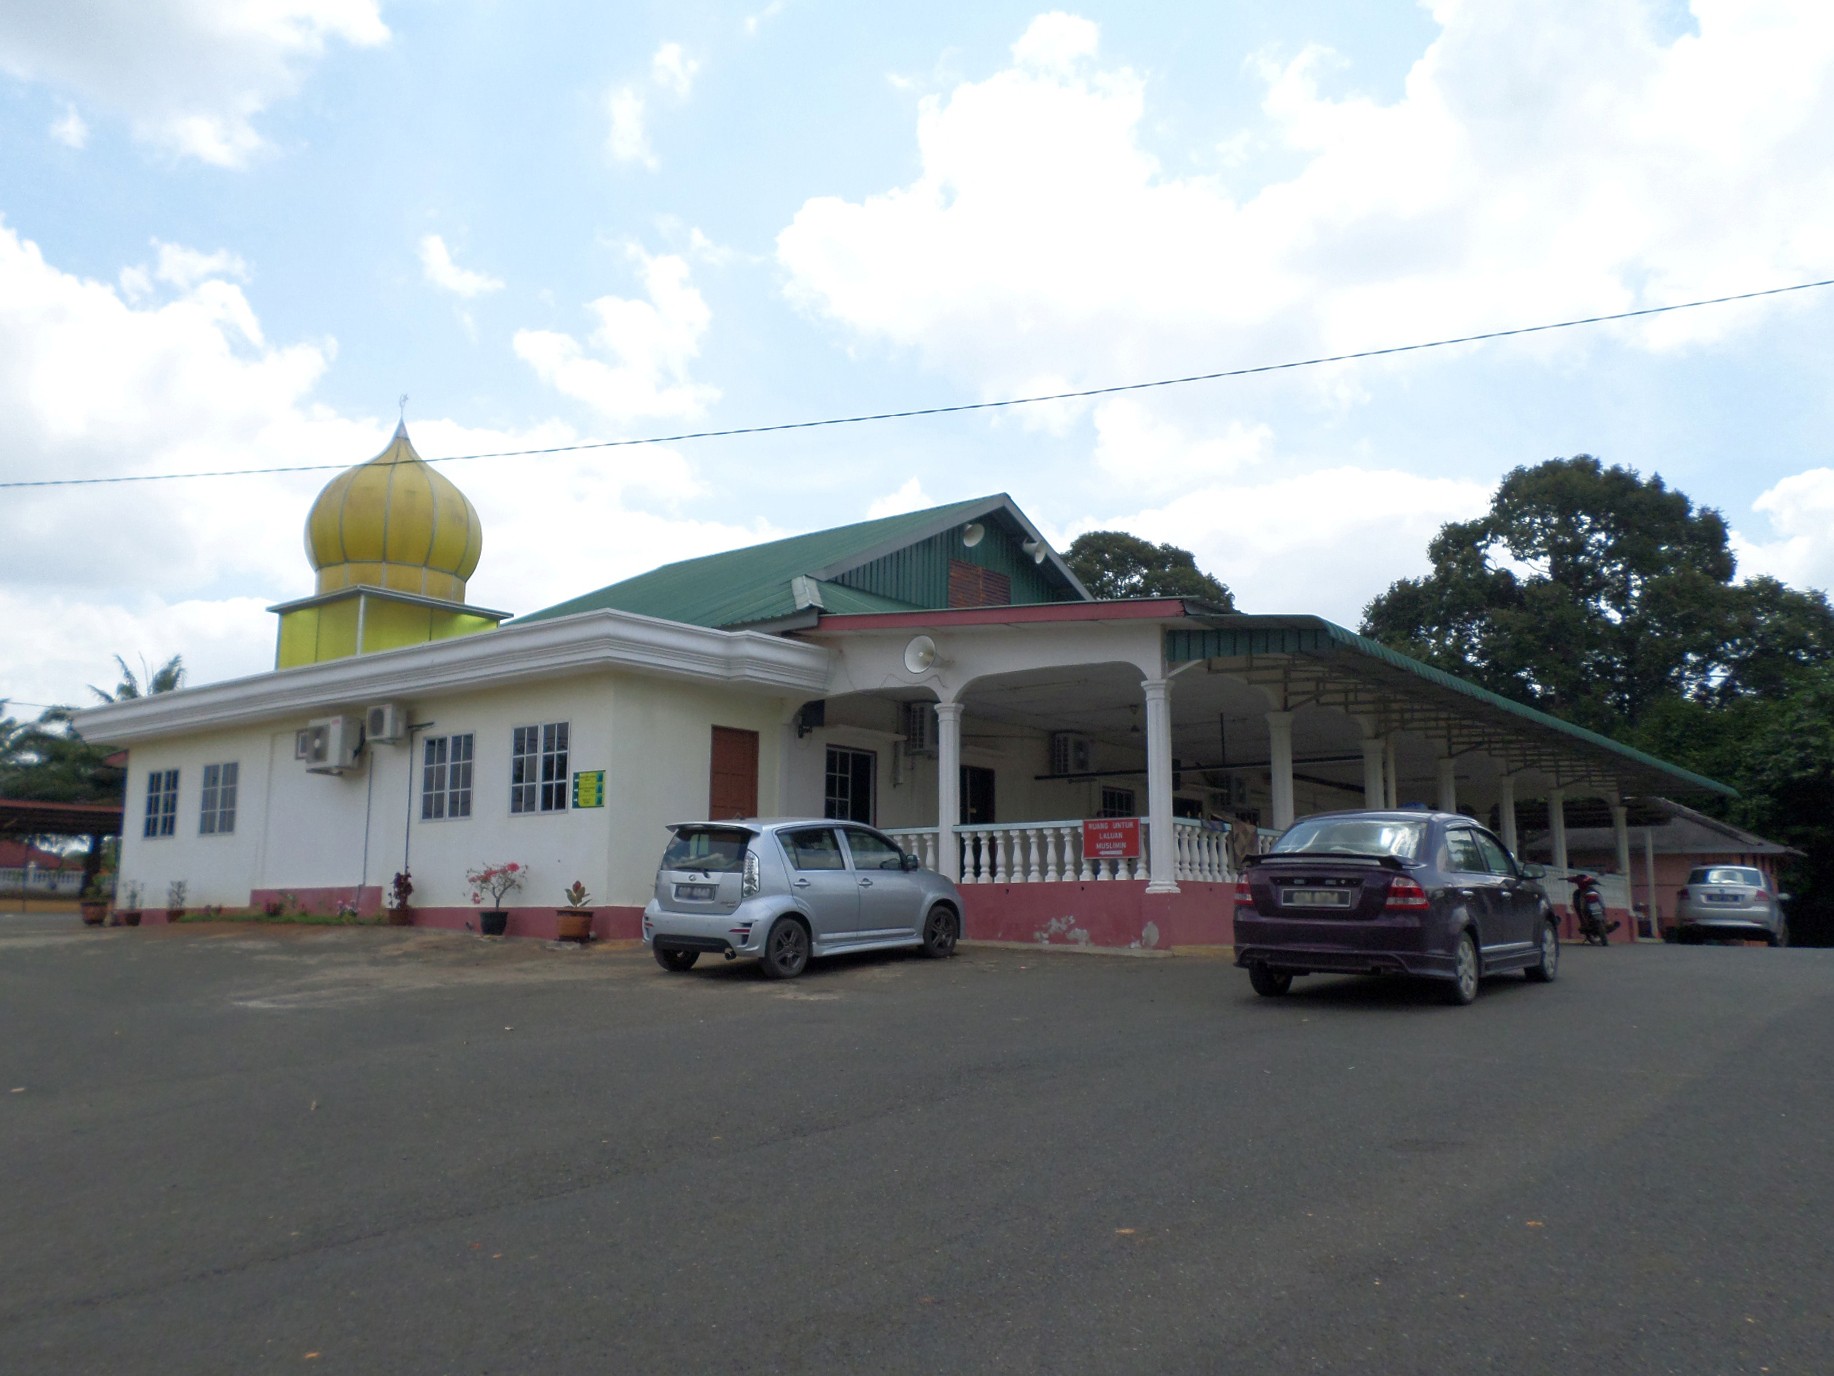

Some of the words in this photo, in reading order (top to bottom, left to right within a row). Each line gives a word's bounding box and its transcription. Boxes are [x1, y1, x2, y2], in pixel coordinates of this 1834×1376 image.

[1088, 822, 1109, 830] RUANG
[1112, 821, 1134, 829] UNTUK
[1099, 832, 1123, 840] LALUAN
